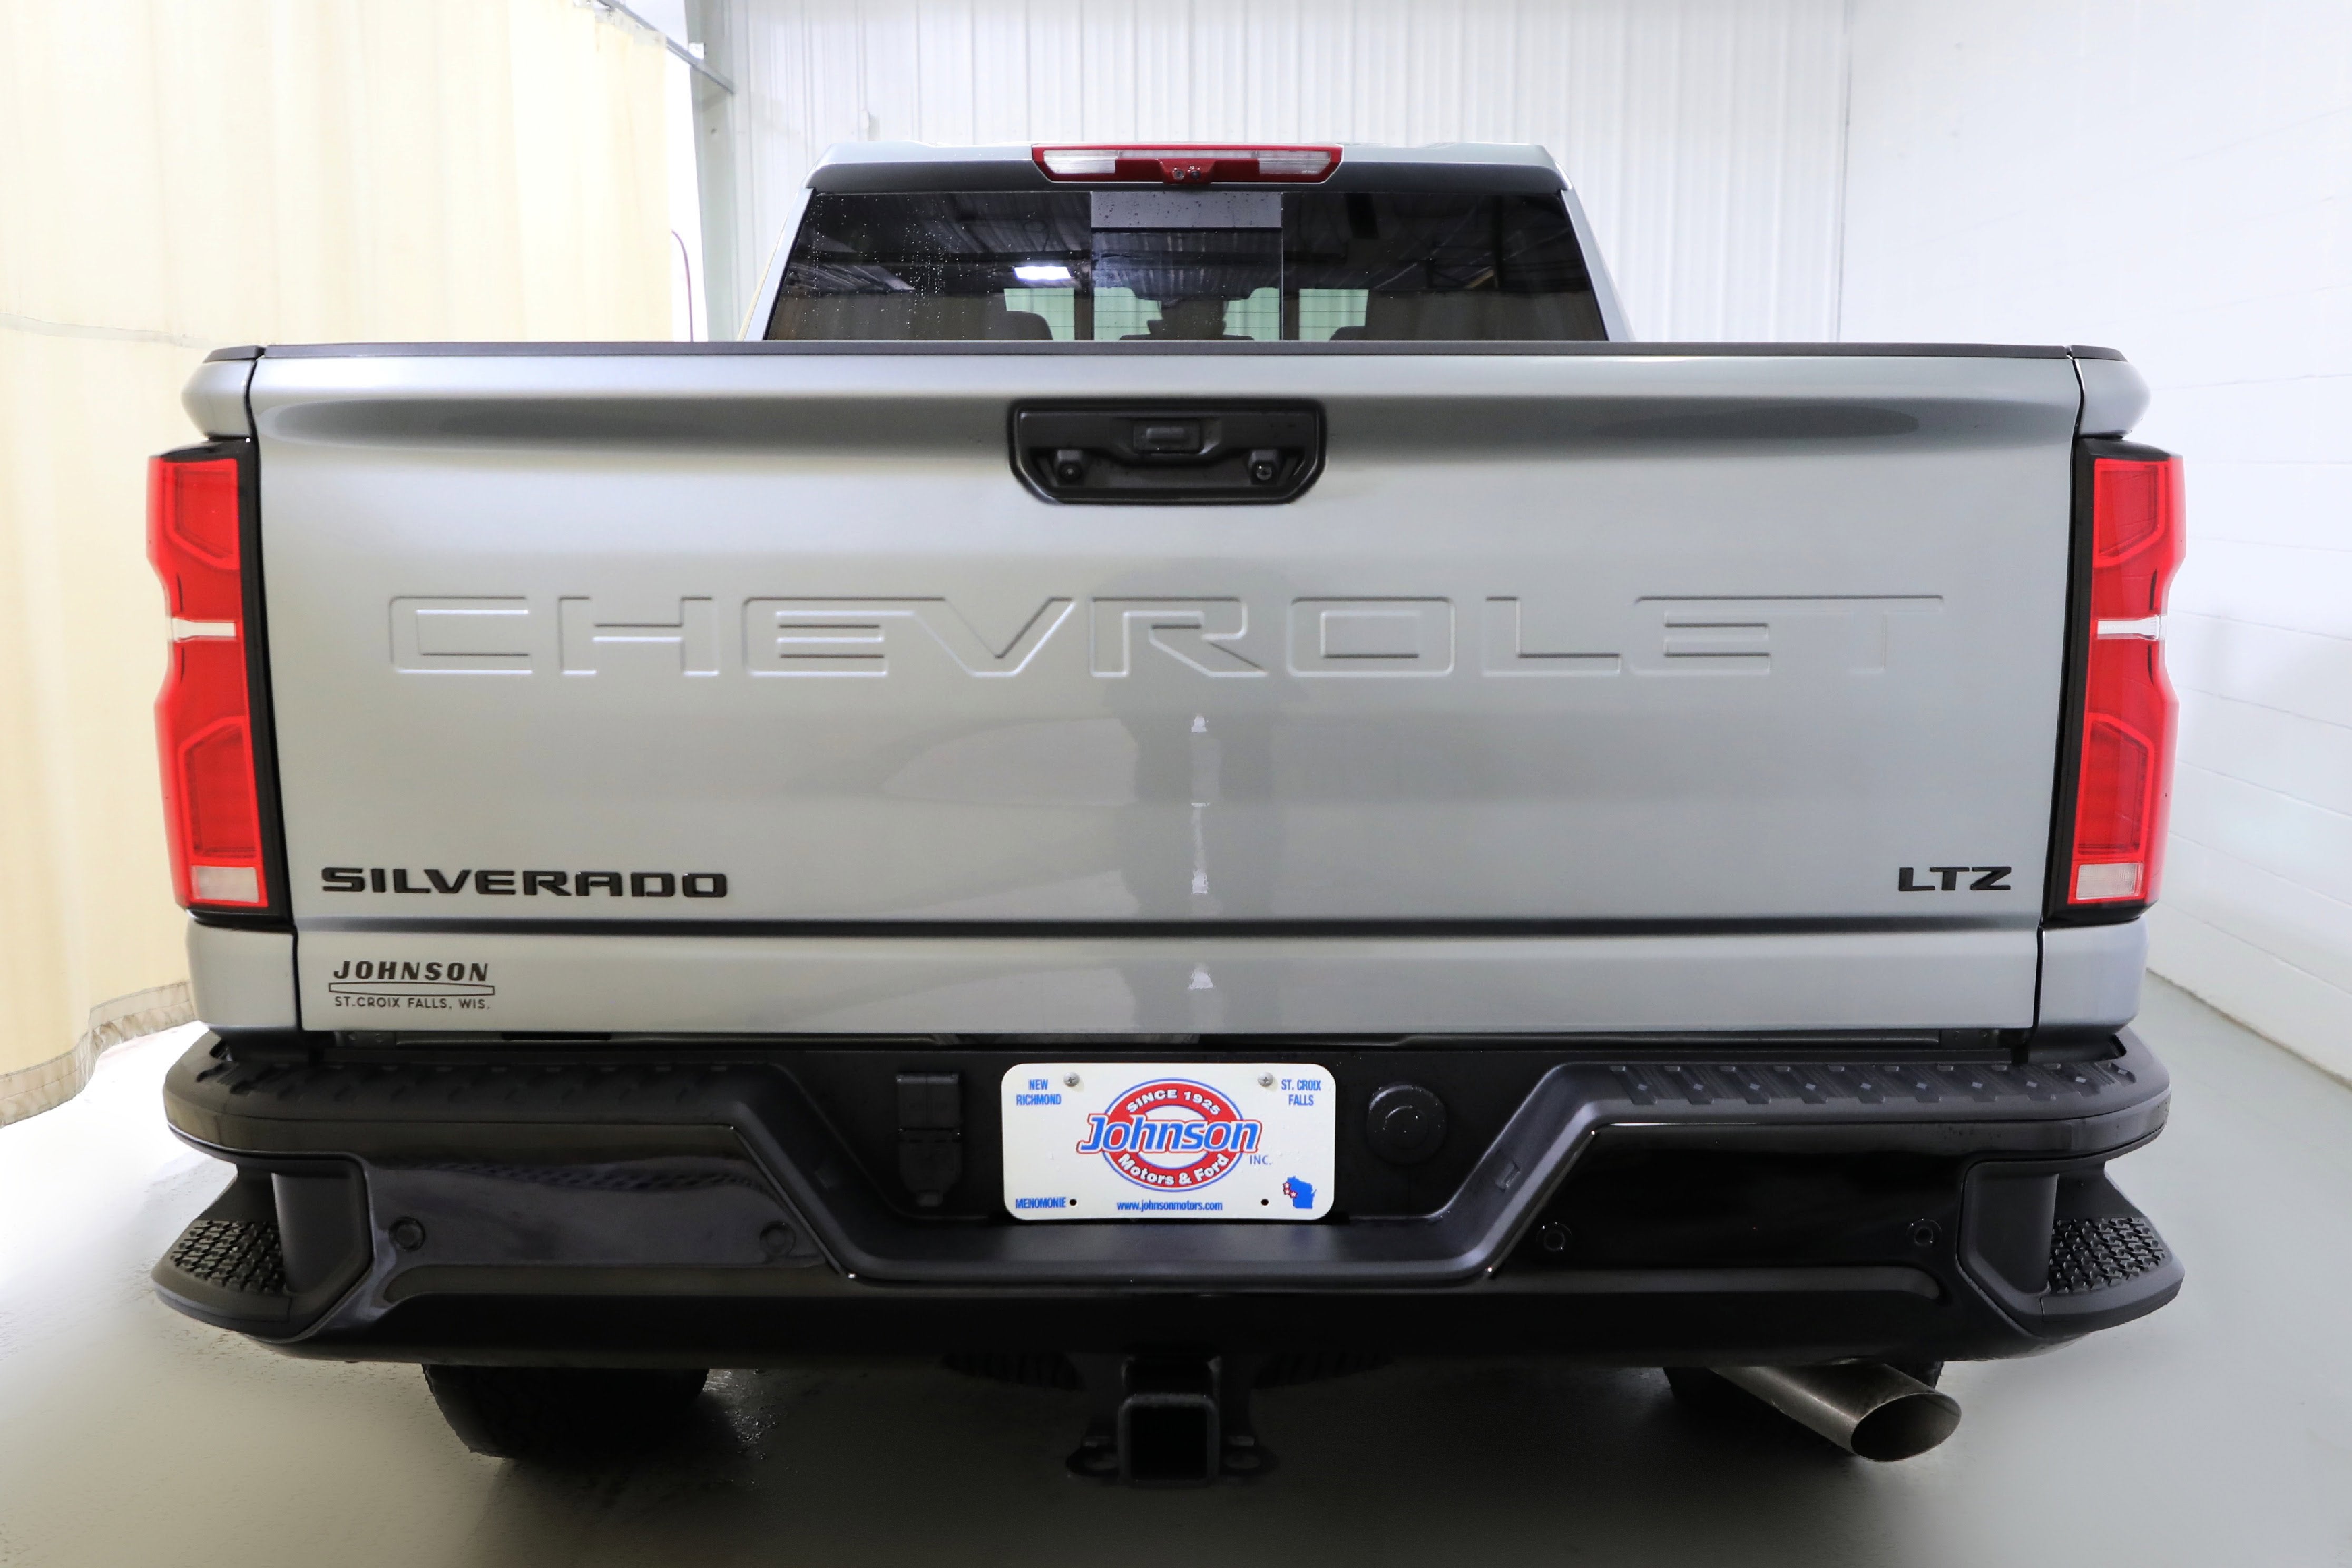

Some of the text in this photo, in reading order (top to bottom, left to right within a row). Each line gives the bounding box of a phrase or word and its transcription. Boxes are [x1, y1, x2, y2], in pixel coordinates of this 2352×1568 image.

[389, 595, 1944, 676] CHEVROLET
[322, 867, 728, 897] SILVERADO
[1898, 867, 2012, 891] LTZ
[333, 961, 488, 981] JOHNSON
[459, 999, 491, 1010] WIS.
[1028, 1079, 1048, 1090] NEW
[1281, 1079, 1321, 1091] ST. CROIX
[1016, 1094, 1061, 1105] RICHMOND
[1126, 1089, 1221, 1115] SINCE 1925
[1289, 1094, 1314, 1106] FALLS
[1076, 1113, 1262, 1154] Johnson
[1250, 1155, 1273, 1165] INC.
[1118, 1153, 1229, 1185] Motors & Ford
[1016, 1197, 1066, 1209] MENOMONIE
[1117, 1200, 1223, 1212] www.johnsonmotors.com
